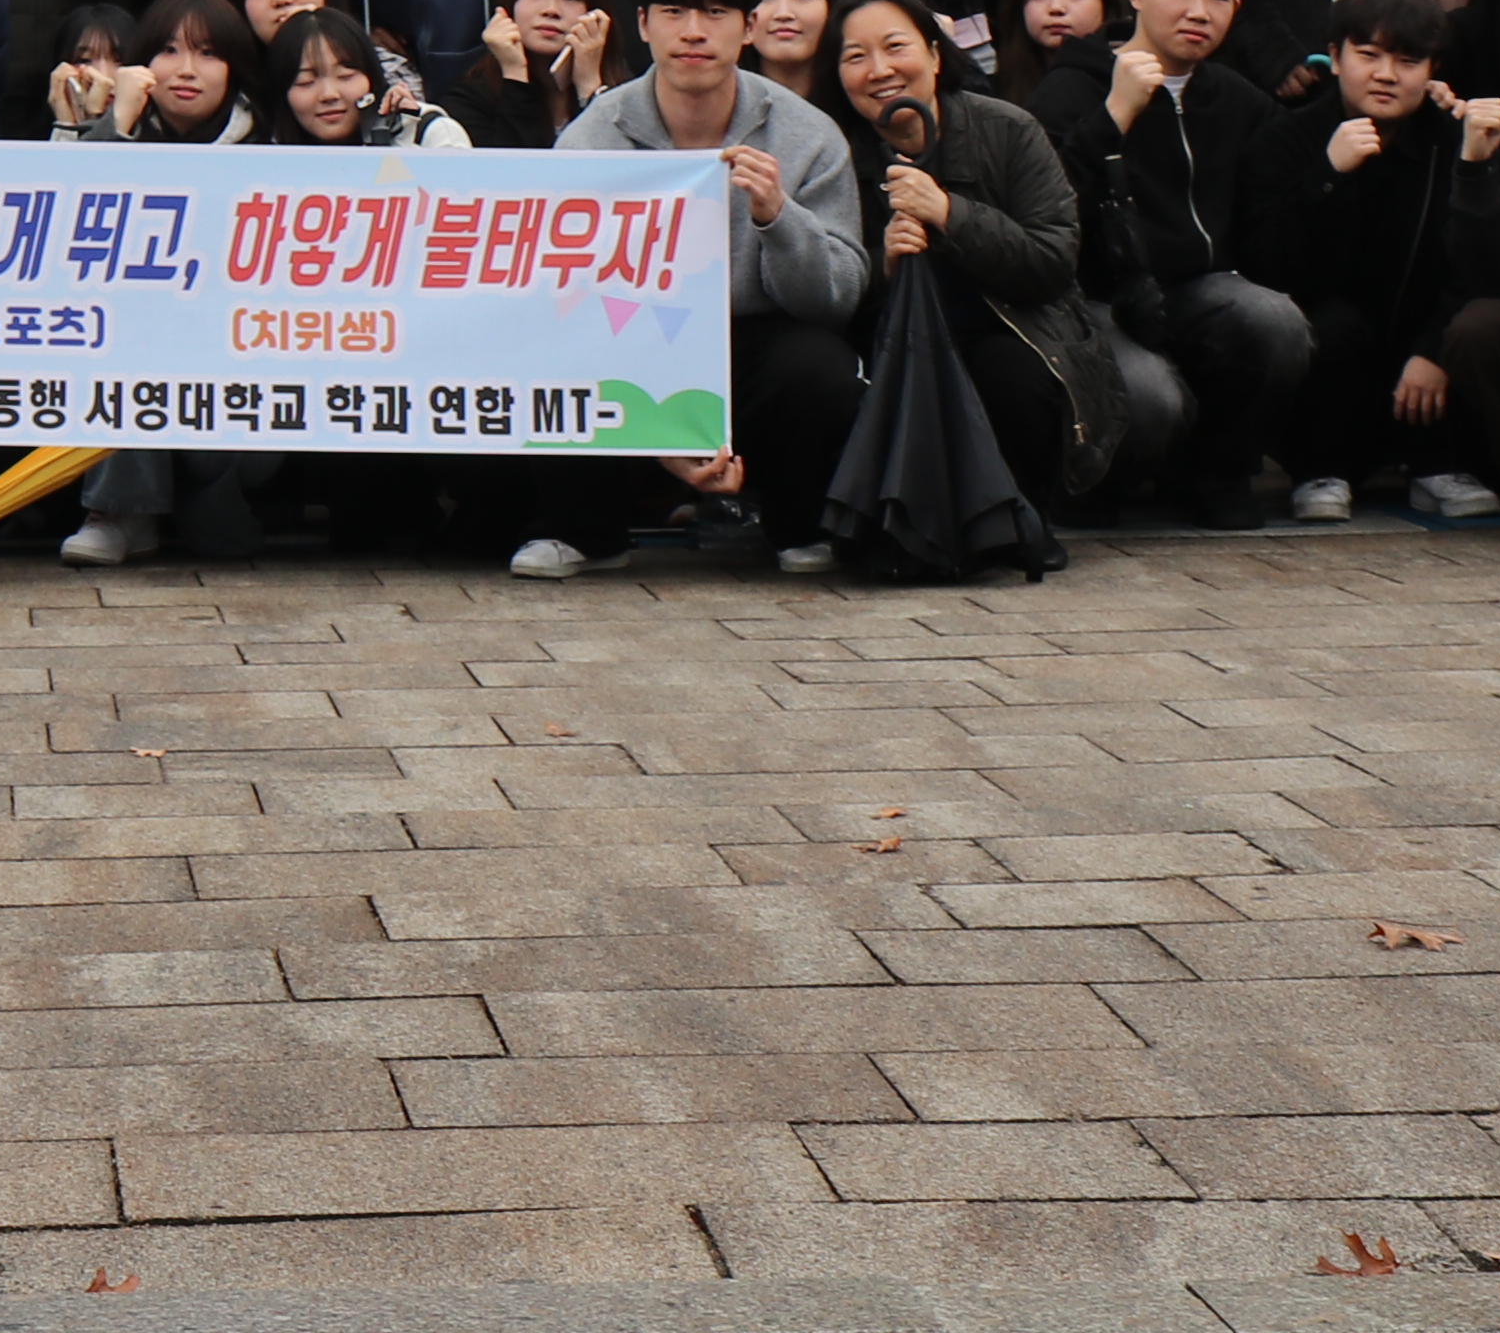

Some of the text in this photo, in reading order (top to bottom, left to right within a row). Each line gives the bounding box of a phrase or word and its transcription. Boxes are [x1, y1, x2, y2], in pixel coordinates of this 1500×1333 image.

[66, 192, 200, 291] 뛰고,
[227, 192, 411, 288] 하얗게
[421, 193, 683, 291] 불태우자!
[232, 307, 396, 353] (치위생)
[85, 380, 308, 433] 서영대학교
[326, 385, 413, 435] 학과
[429, 385, 515, 435] 연합
